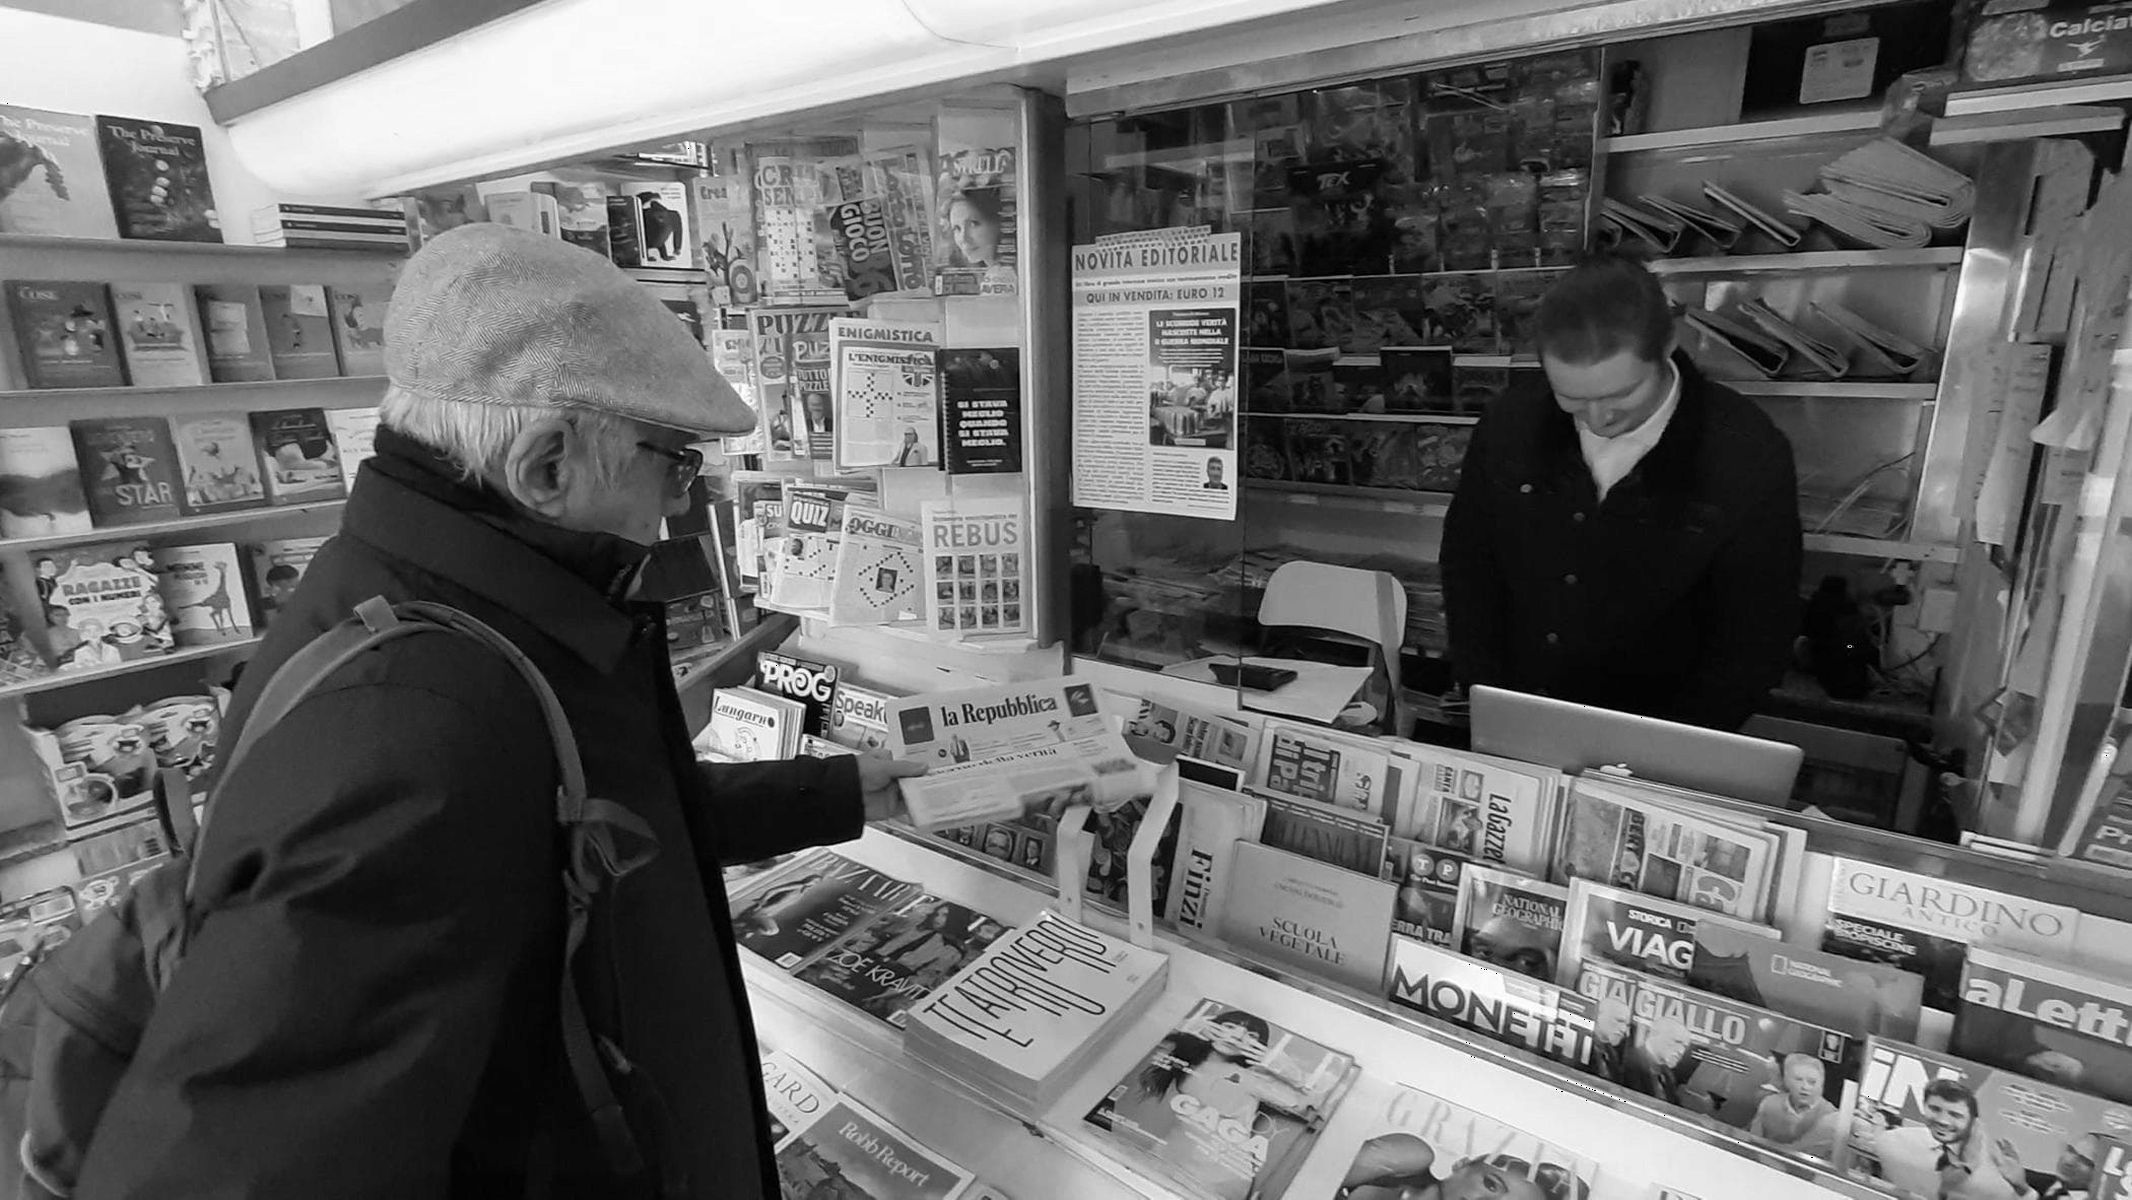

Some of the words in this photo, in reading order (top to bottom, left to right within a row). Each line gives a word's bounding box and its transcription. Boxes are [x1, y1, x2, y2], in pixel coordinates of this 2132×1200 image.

[2050, 15, 2132, 38] Calcia
[840, 203, 870, 262] GIOCO
[860, 200, 889, 254] BUON
[1142, 242, 1238, 267] EDITORIALE
[1086, 292, 1105, 304] QUI
[1109, 292, 1120, 302] IN
[1124, 289, 1173, 302] VENDITA:
[1177, 287, 1208, 300] EURO
[1213, 286, 1225, 298] 12
[837, 326, 934, 343] ENIGMISTICA
[116, 482, 173, 505] STAR
[789, 500, 829, 528] QUIZ
[933, 521, 1018, 548] REBUS
[759, 659, 832, 702] PROG
[940, 706, 959, 727] la
[961, 694, 1058, 725] Repubblica
[1503, 893, 1560, 918] NATIONAL
[1628, 909, 1672, 929] STORICA
[1850, 872, 2061, 937] GIARDINO
[1273, 917, 1338, 949] SCUOLA
[1834, 918, 1904, 943] SPECIALE
[1903, 906, 1997, 937] ANTICO
[1260, 926, 1347, 966] VEGETALE
[1607, 920, 1694, 970] VIAG
[1635, 989, 1746, 1045] GIALLO
[1964, 977, 2132, 1044] aLett
[1170, 1094, 1269, 1164] GAGA
[838, 1121, 881, 1155] Robb
[876, 1143, 931, 1187] Report
